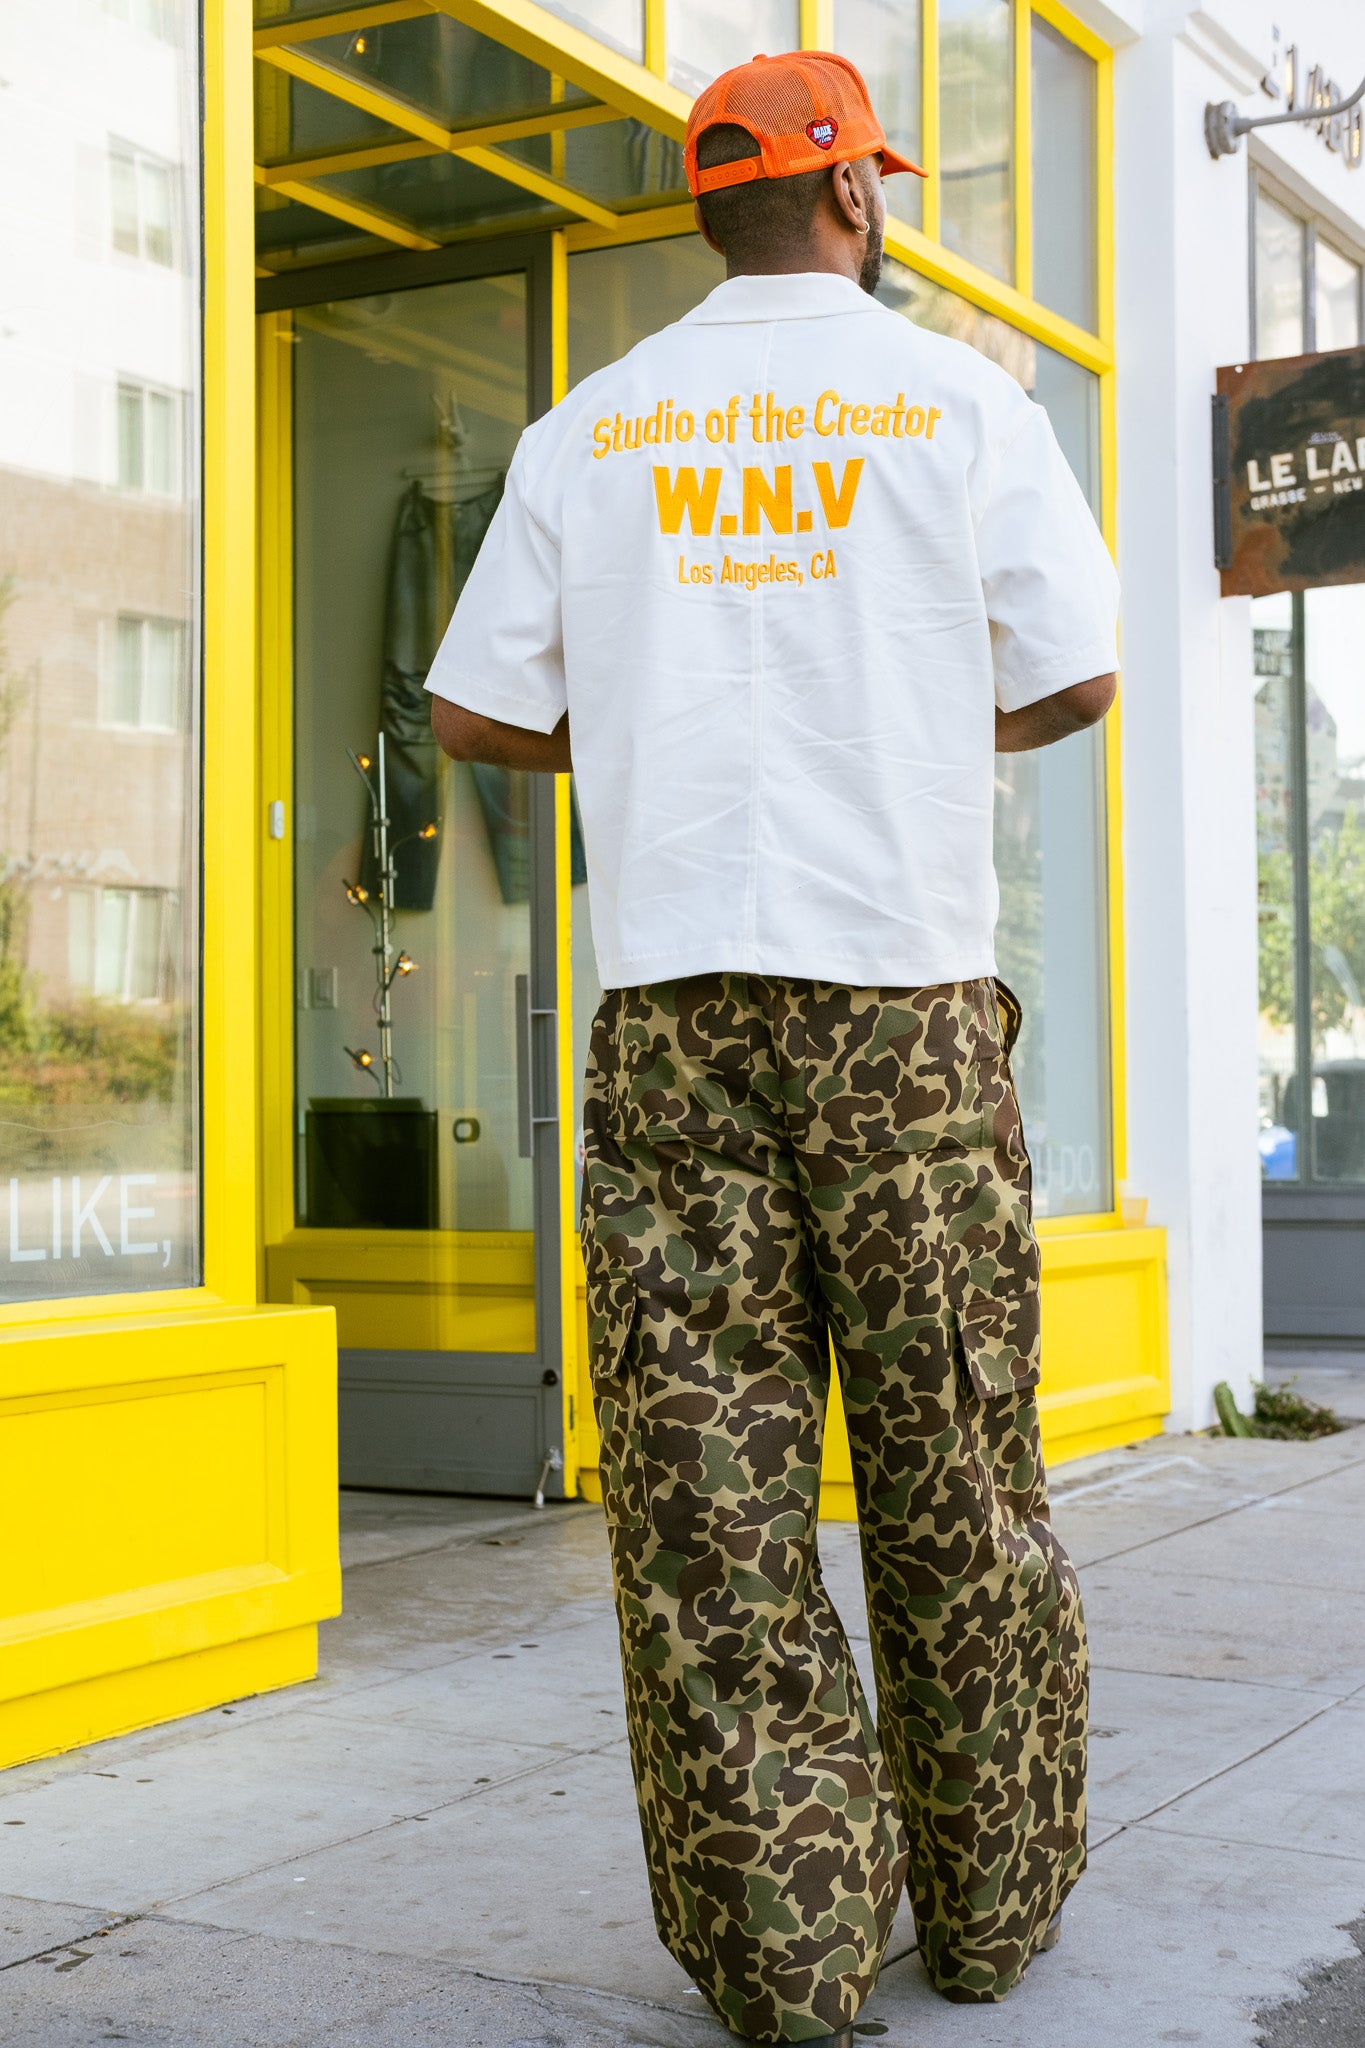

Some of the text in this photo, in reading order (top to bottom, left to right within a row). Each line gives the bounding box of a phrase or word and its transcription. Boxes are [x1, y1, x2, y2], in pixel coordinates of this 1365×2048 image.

[593, 390, 942, 460] Studio of the Creator
[653, 458, 865, 537] W.N.V
[1248, 454, 1296, 492] LE
[679, 549, 838, 591] Los Angeles, CA
[10, 1174, 171, 1268] LIKE,
